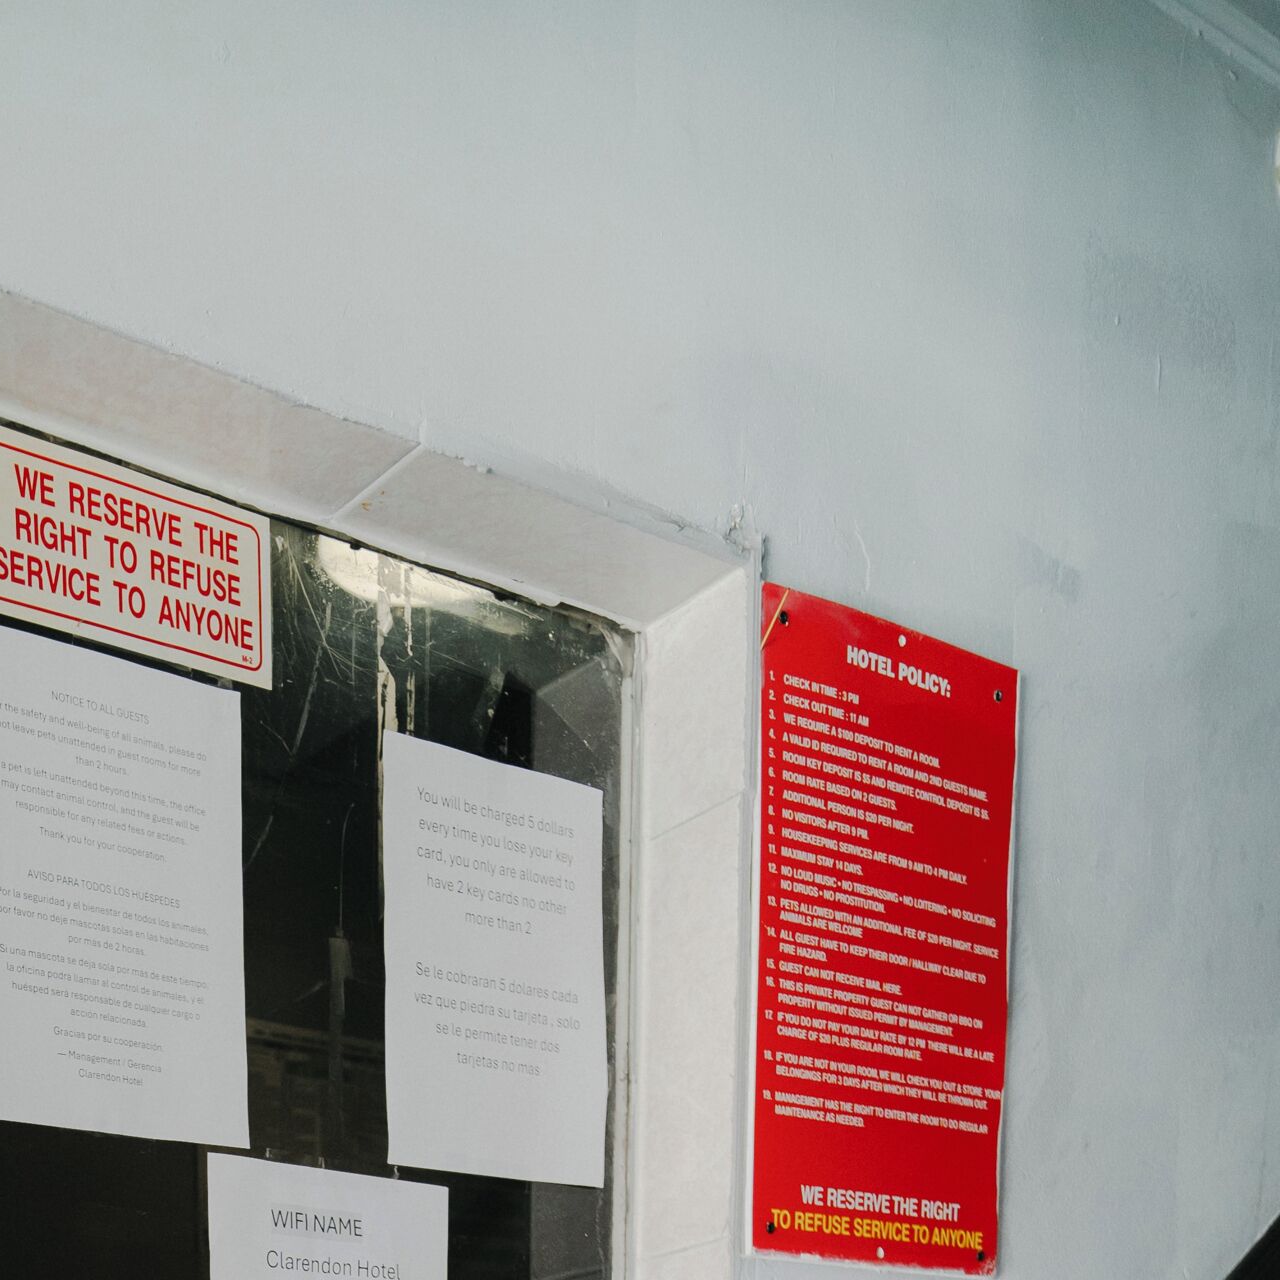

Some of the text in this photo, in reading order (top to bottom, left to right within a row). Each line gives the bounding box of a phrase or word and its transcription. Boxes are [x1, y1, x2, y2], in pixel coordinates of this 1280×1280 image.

[14, 464, 239, 565] WE RESERVE THE
[15, 507, 241, 607] RIGHT TO REFUSE
[112, 580, 146, 619] TO
[158, 595, 253, 651] ANYONE
[847, 644, 951, 698] HOTEL POLICY:
[51, 690, 149, 725] NOTICE TO ALL GUESTS
[782, 769, 806, 785] ROOM
[806, 776, 826, 791] RATE
[826, 781, 851, 797] BASED
[868, 793, 897, 811] GUESTS.
[417, 786, 574, 838] You will be charged 5 dollars
[418, 818, 573, 867] every time you lose your key
[416, 846, 575, 891] card, you only are allowed to
[427, 873, 566, 915] have 2 key cards no other
[465, 912, 532, 935] more than 2
[271, 1209, 363, 1237] WIFI NAME
[800, 1184, 961, 1222] WE RESERVE THE RIGHT
[771, 1208, 983, 1251] TO REFUSE SERVICE TO ANYONE
[266, 1250, 400, 1280] Clarendon Hotel
